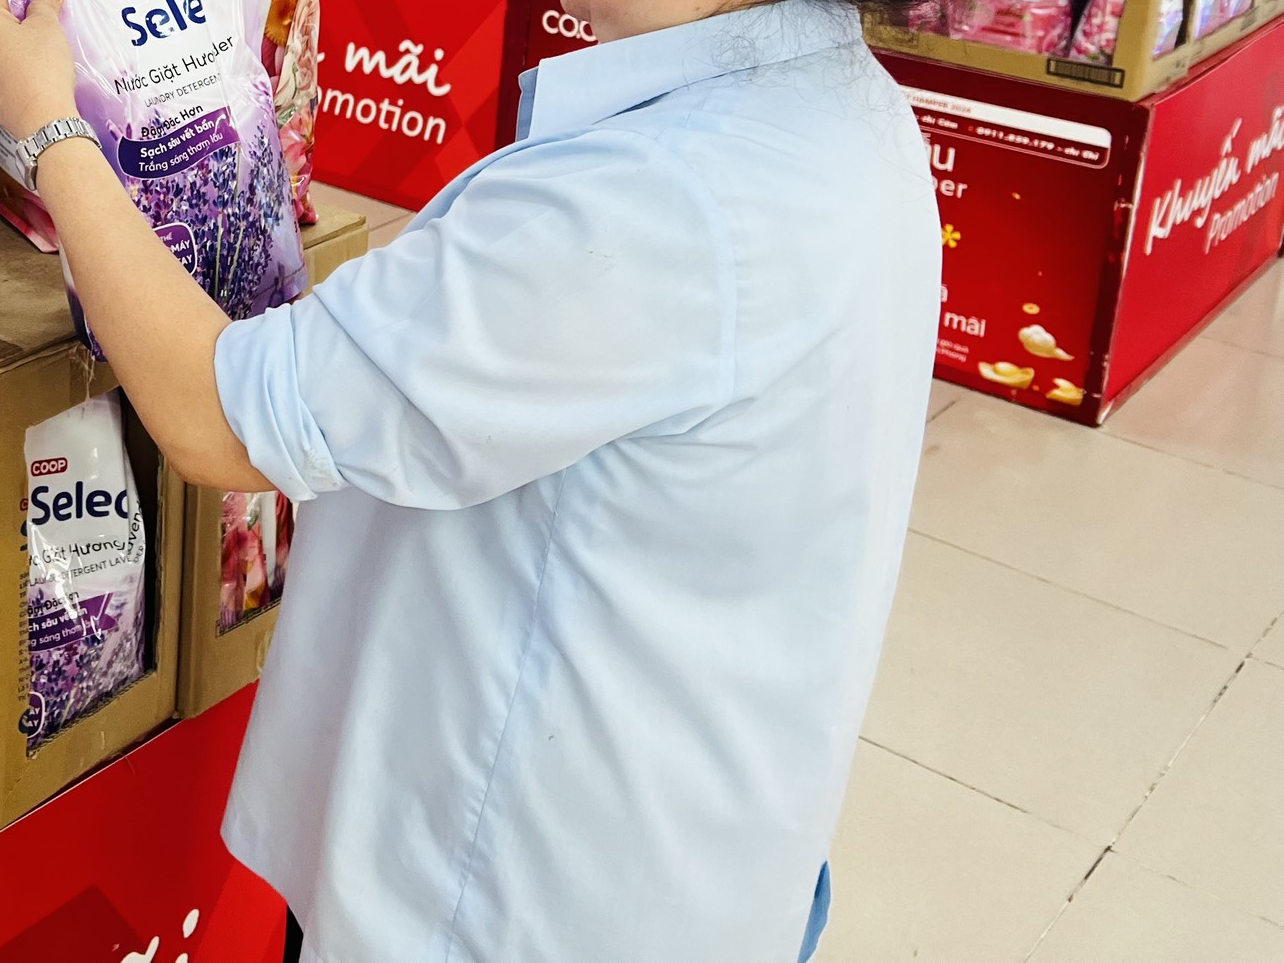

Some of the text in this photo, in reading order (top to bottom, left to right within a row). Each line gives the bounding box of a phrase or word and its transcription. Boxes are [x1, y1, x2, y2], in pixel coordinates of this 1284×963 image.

[149, 60, 182, 86] Giặt
[345, 38, 452, 97] mãi
[179, 104, 204, 122] Hơn
[140, 144, 167, 161] Sạch
[138, 158, 169, 175] Trắng
[1143, 117, 1244, 256] Khuyến
[1204, 170, 1280, 256] Promotion
[31, 458, 67, 477] COOP
